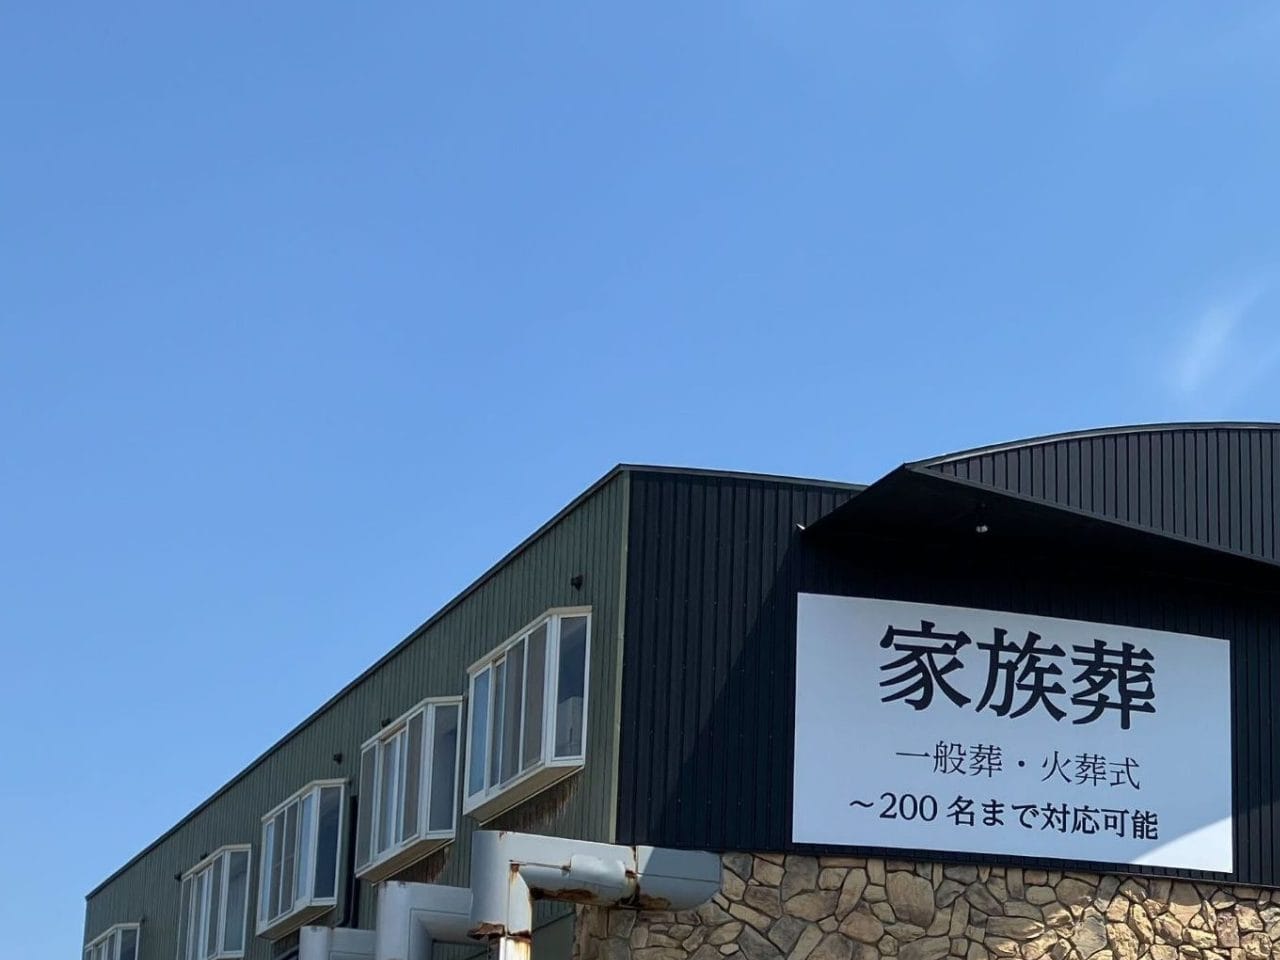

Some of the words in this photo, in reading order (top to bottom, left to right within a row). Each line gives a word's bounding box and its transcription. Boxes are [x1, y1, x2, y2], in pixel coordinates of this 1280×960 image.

[879, 620, 1156, 730] 家族葬
[895, 741, 1141, 790] 一般葬・火葬式
